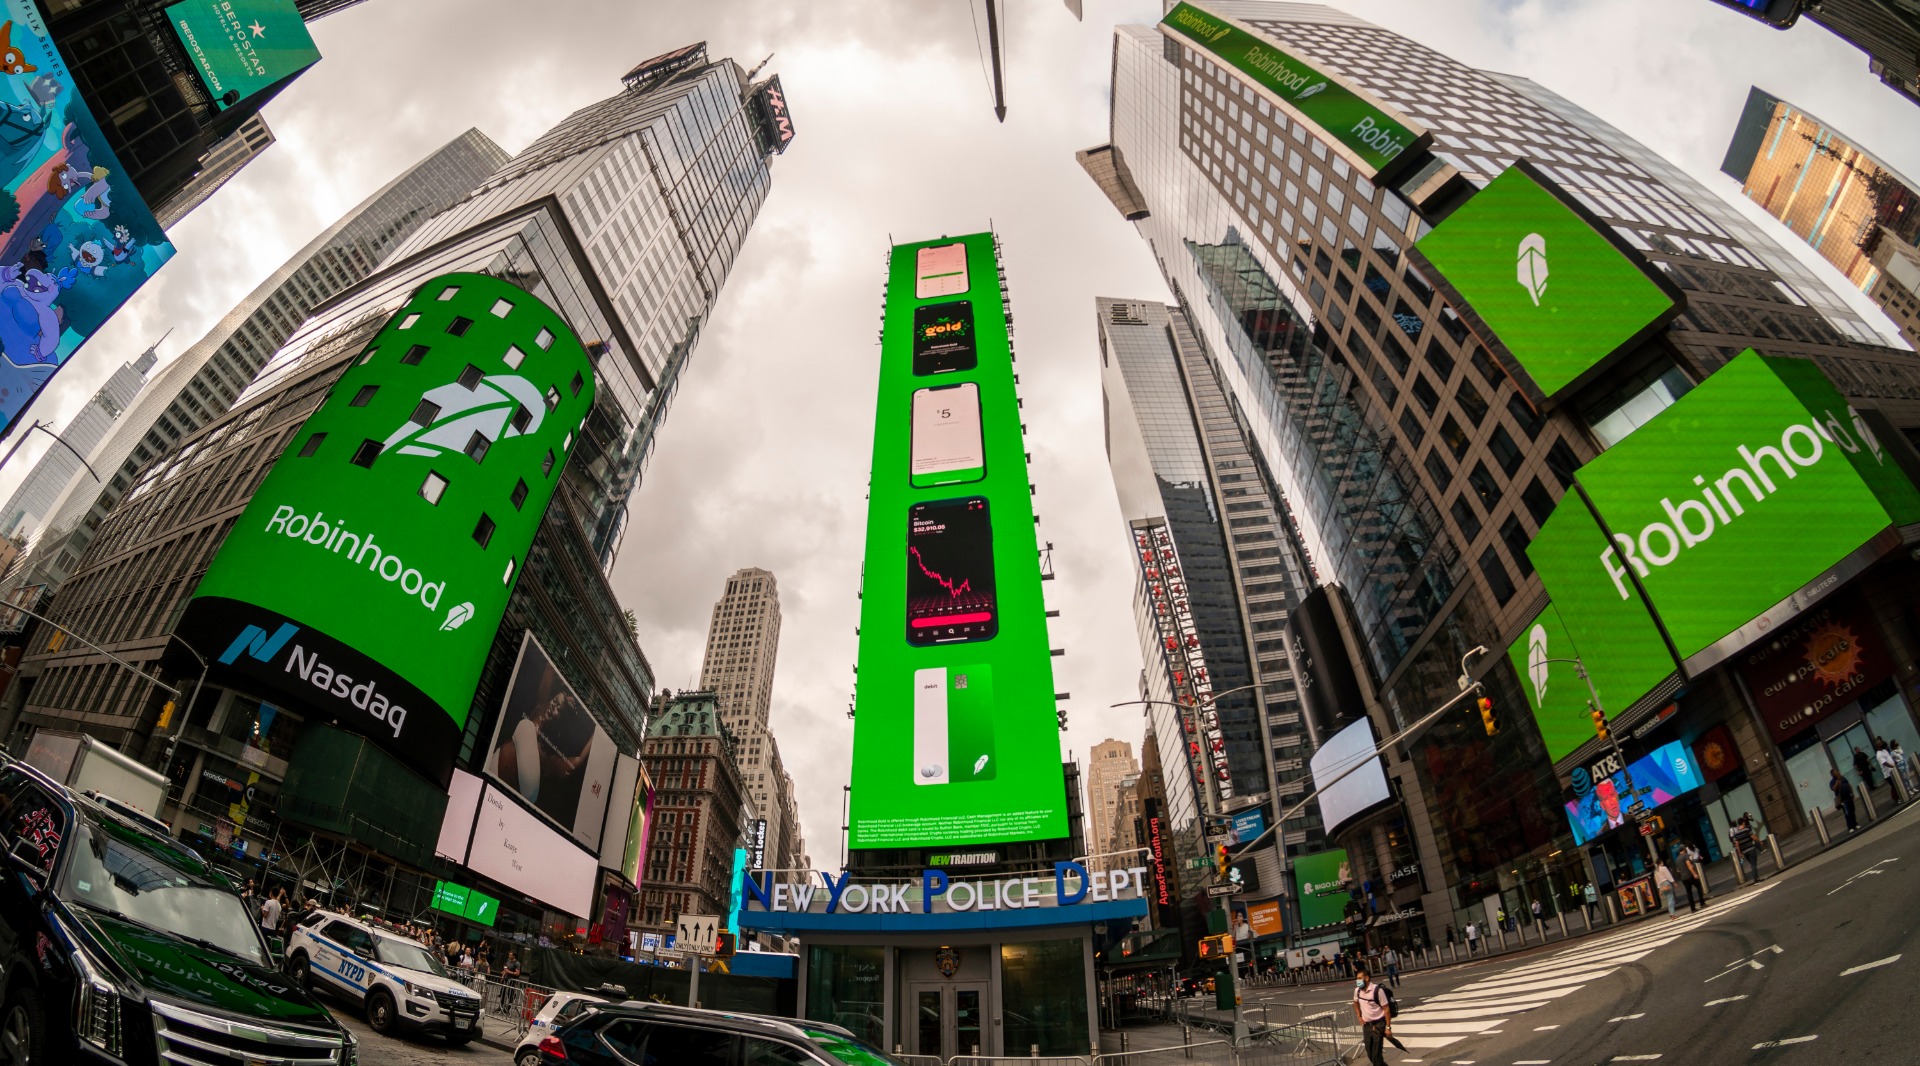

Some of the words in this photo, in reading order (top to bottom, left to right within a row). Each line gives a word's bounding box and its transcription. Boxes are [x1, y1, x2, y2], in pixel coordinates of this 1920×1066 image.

[212, 4, 231, 33] HOTELS
[233, 43, 254, 77] RESORTS
[218, 0, 266, 76] BEROSTAR
[1175, 8, 1217, 38] Robinhood
[39, 36, 63, 77] SERIES
[180, 20, 223, 91] IBEROSTAR.COM
[1243, 46, 1311, 91] Robinhood
[925, 321, 962, 337] gold
[264, 504, 446, 612] Robinhood
[1806, 574, 1838, 598] REUTERS
[284, 644, 407, 738] Nasdaq
[1764, 660, 1816, 697] europa
[1779, 693, 1833, 730] europa
[755, 821, 766, 848] Locker
[753, 851, 763, 869] Foot
[1150, 817, 1169, 905] ApexForYouth.org
[822, 870, 911, 914] YORK
[923, 869, 1040, 913] POLICE
[1054, 860, 1148, 906] DEPT
[1314, 882, 1331, 891] BIGO
[1331, 879, 1346, 887] LIVE
[675, 942, 688, 950] ONLY
[338, 958, 365, 983] NYPD
